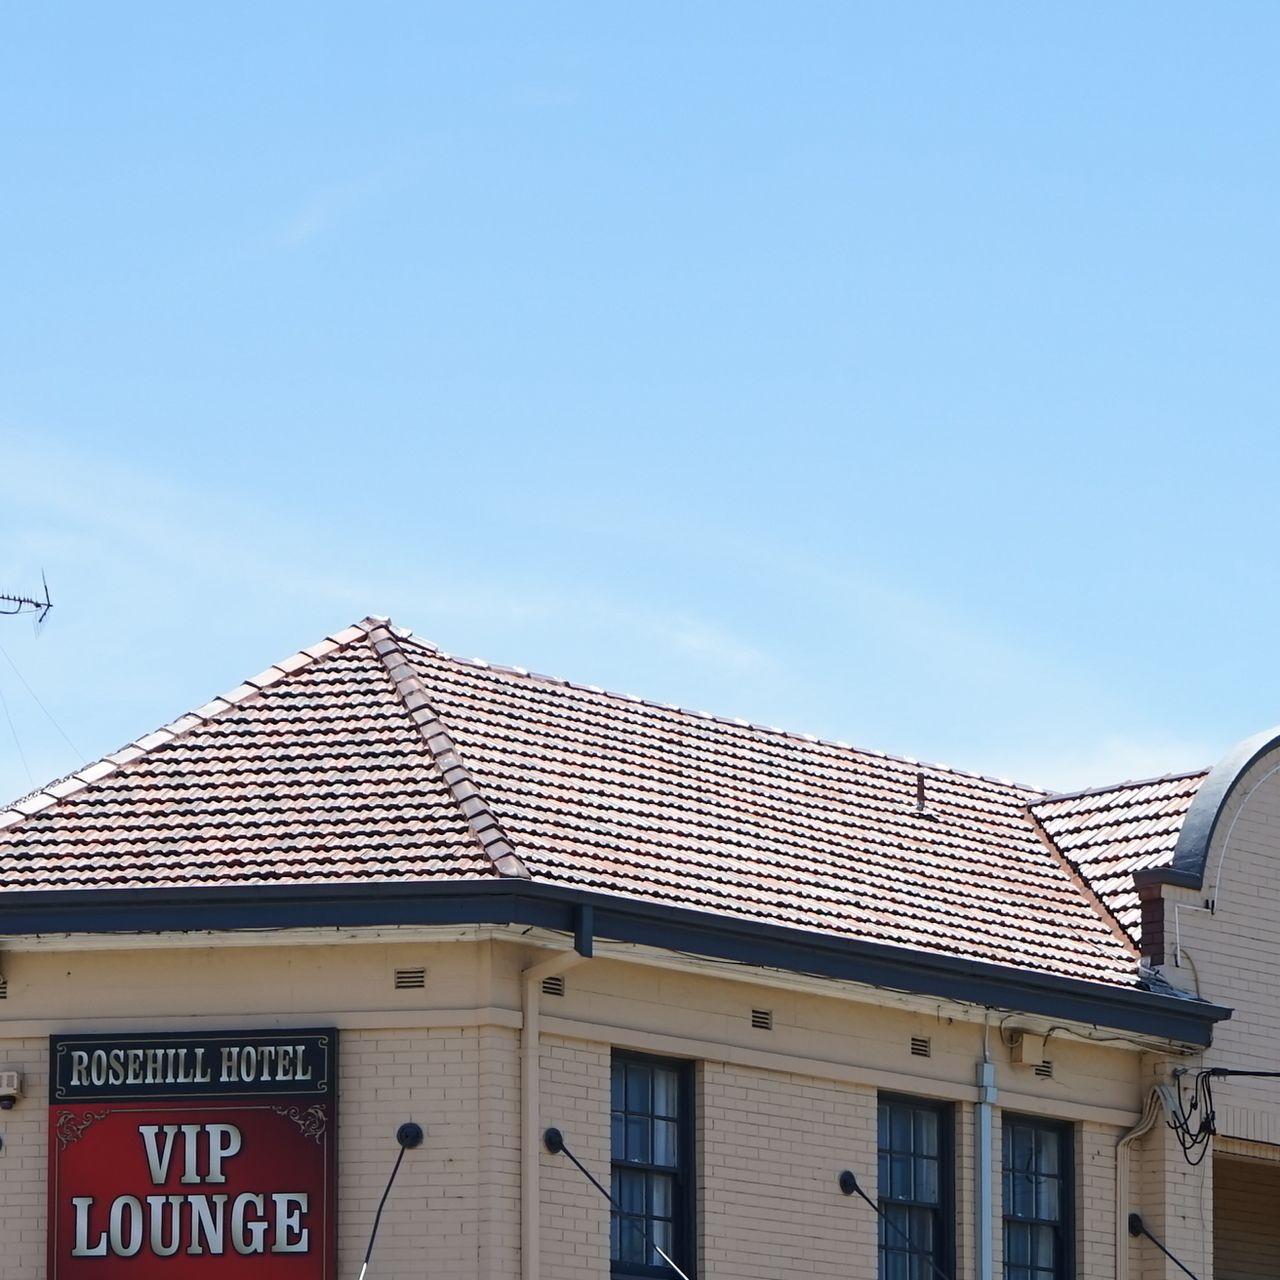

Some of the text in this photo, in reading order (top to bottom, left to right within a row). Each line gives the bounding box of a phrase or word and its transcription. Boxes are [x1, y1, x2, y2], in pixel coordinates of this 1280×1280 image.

[70, 1045, 312, 1086] ROSEHILL HOTEL
[138, 1123, 242, 1185] VIP
[71, 1192, 309, 1257] LOUNGE
